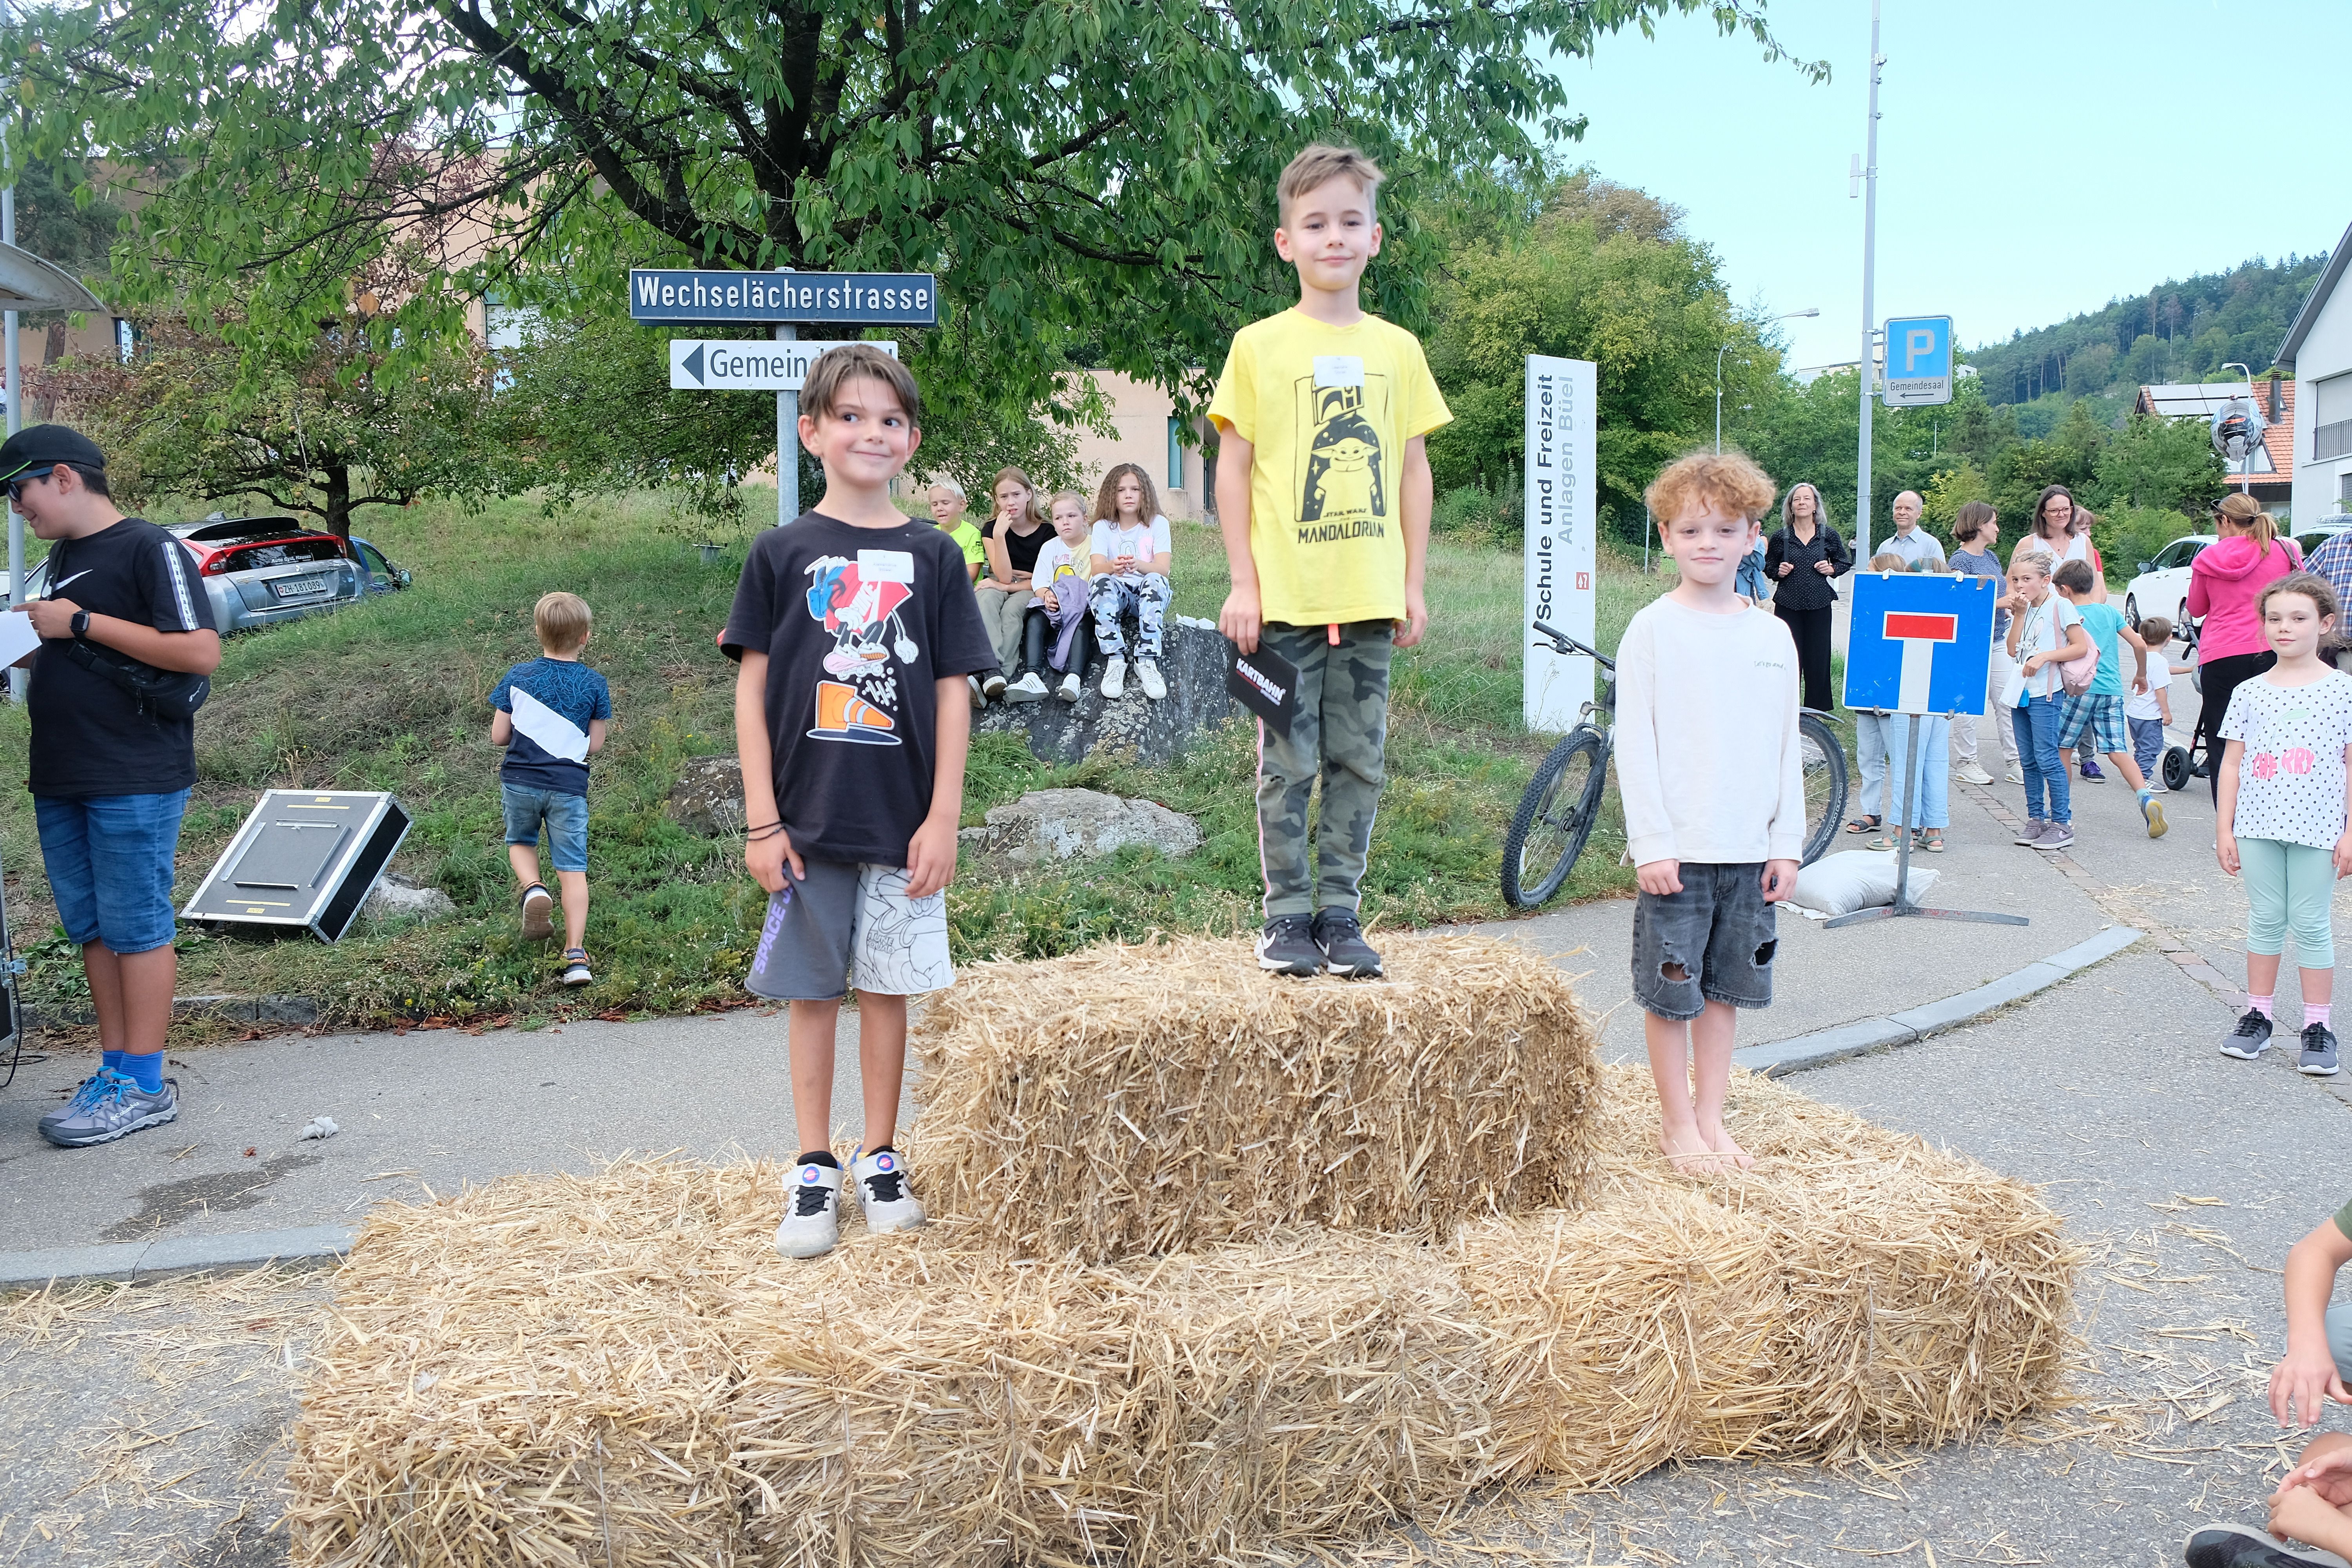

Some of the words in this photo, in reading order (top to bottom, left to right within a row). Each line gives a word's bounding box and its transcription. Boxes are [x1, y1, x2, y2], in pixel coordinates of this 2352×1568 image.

[637, 276, 928, 310] Wechselächerstrasse
[710, 348, 824, 378] Gemein
[1906, 329, 1935, 371] P
[1558, 376, 1573, 431] Büel
[1890, 380, 1944, 391] Gemeindesaal
[1537, 374, 1552, 467] Freizeit
[1537, 479, 1552, 524] und
[1558, 443, 1576, 545] Anlagen
[1298, 520, 1384, 544] MANDALORIAN
[1536, 535, 1552, 620] Schule
[1236, 658, 1284, 701] KARTBAHN
[1822, 812, 1838, 842] CONTROL
[754, 902, 786, 975] SPACE
[115, 1102, 140, 1118] Columbia
